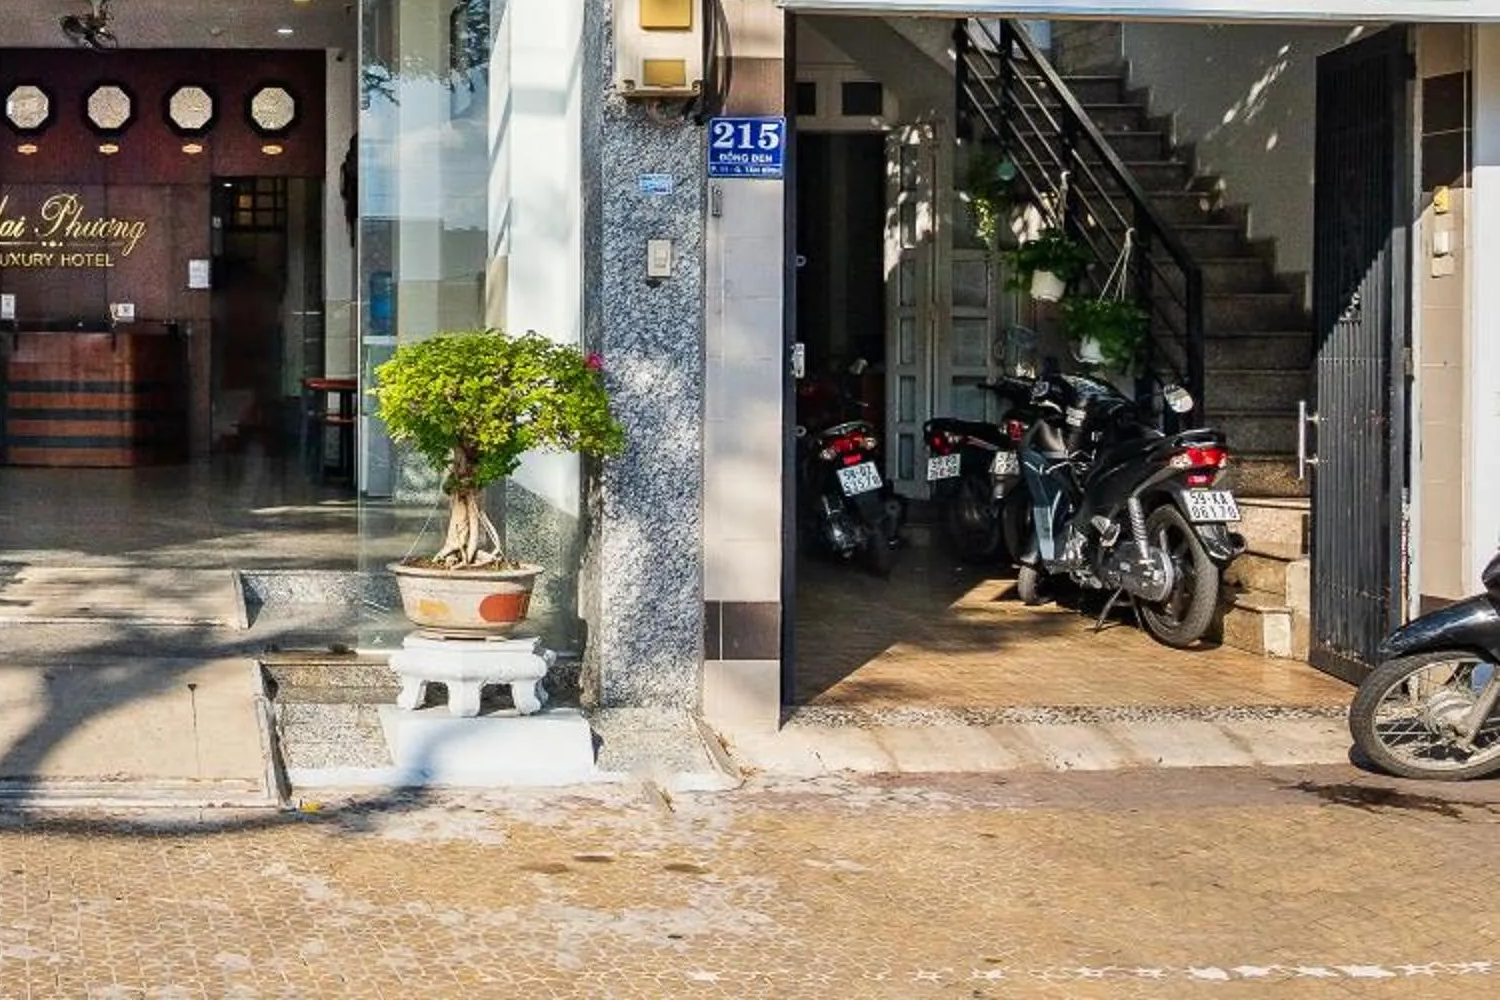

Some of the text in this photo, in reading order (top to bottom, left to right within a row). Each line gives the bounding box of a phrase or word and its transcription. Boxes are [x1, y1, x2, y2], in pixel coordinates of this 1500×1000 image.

[712, 121, 780, 150] 215
[35, 192, 148, 257] Phương
[61, 253, 114, 267] HOTEL
